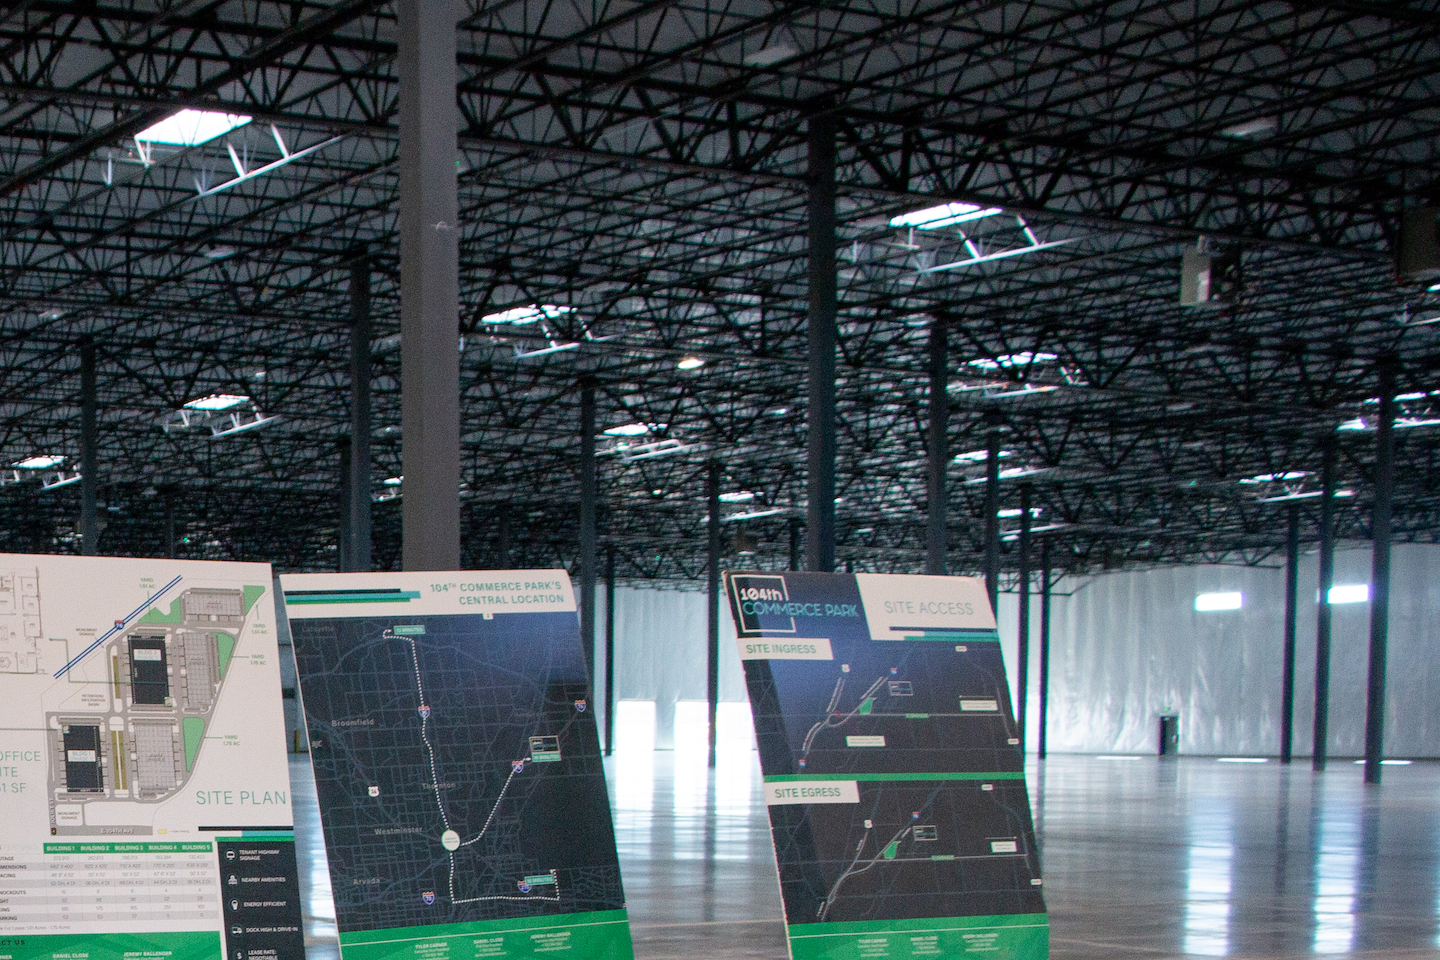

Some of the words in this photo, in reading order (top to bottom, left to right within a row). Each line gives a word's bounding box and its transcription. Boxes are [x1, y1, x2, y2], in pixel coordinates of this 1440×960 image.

[430, 583, 457, 592] 104TH
[460, 582, 522, 591] COMMERCE
[525, 581, 562, 590] PARK'S
[459, 596, 508, 605] CENTRAL
[512, 594, 564, 604] LOCATION
[740, 588, 783, 601] 104th
[742, 602, 823, 616] COMMERCE
[824, 604, 859, 617] PARK
[884, 601, 915, 614] SITE
[920, 602, 974, 615] ACCESS
[746, 644, 770, 653] SITE
[772, 644, 816, 653] INGRESS
[332, 719, 374, 727] Broomfield
[11, 782, 26, 793] SF
[774, 788, 798, 798] SITE
[801, 787, 841, 797] EGRESS
[196, 790, 234, 805] SITE
[240, 791, 286, 805] PLAN
[374, 827, 422, 835] Westminster
